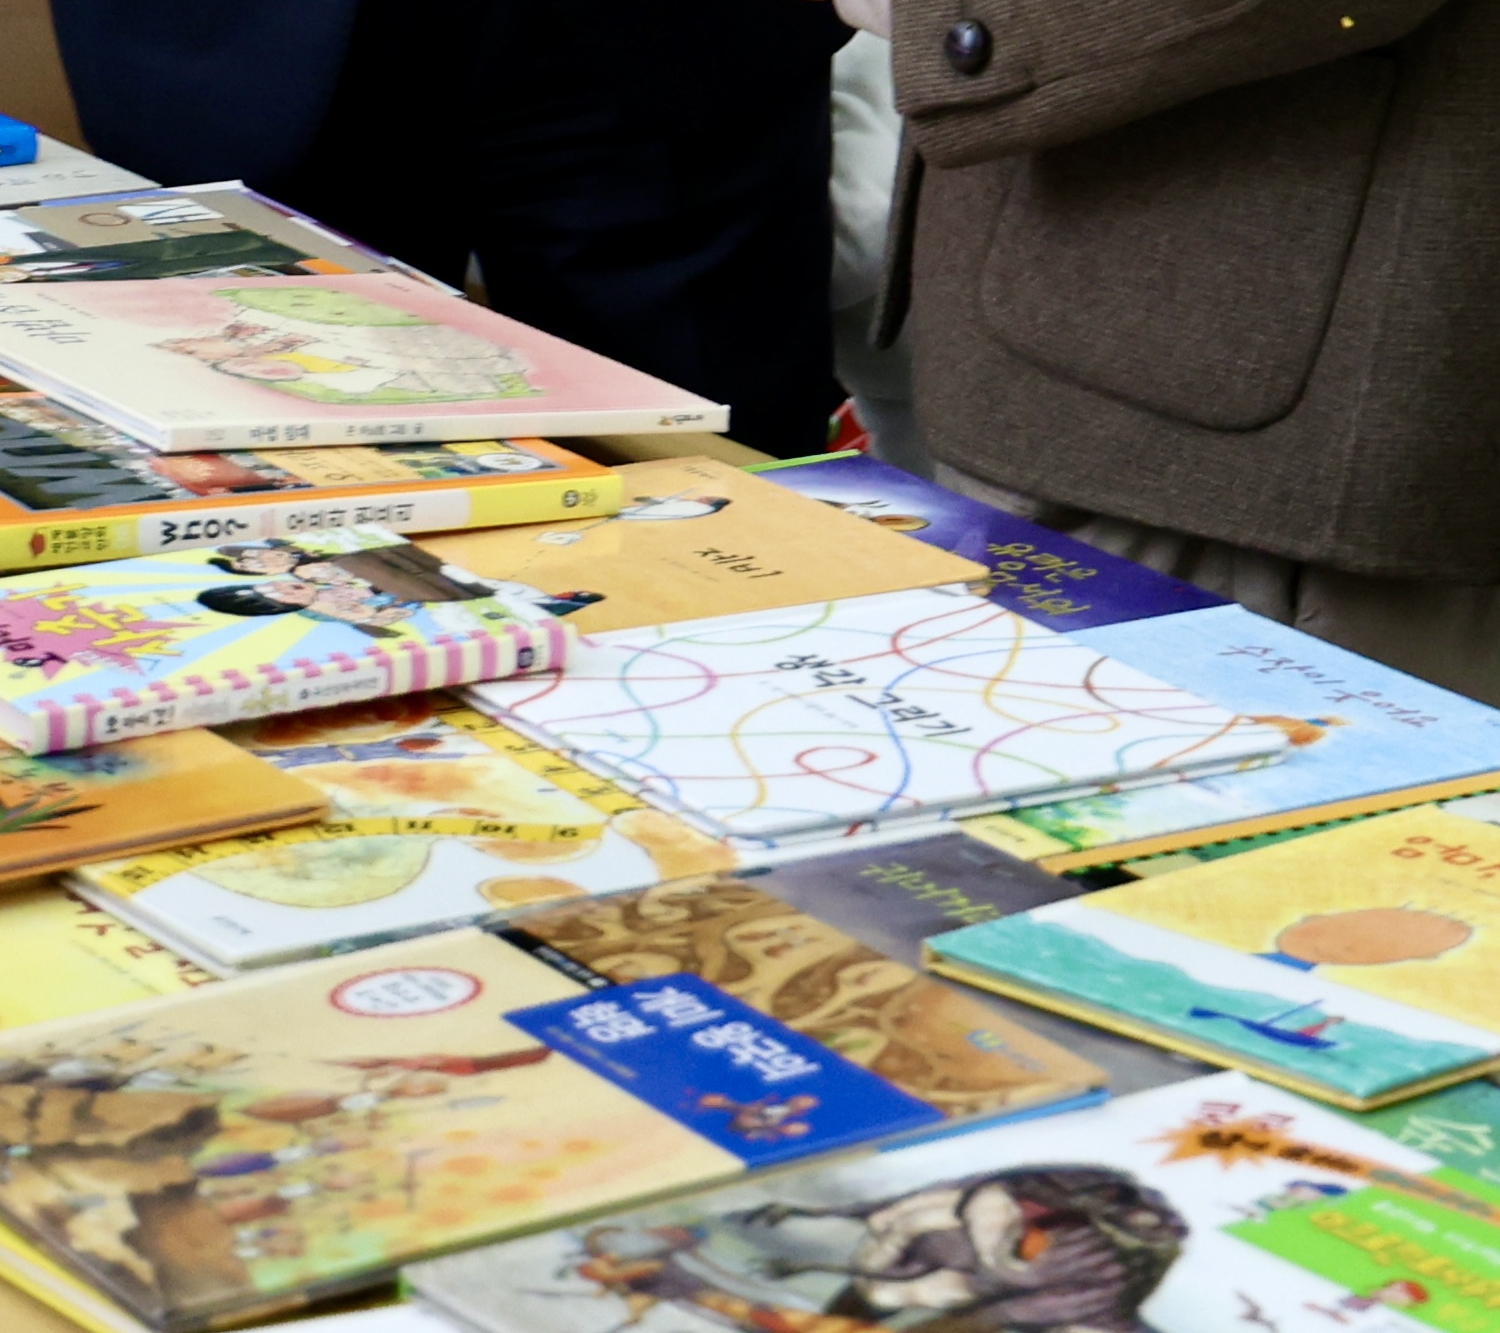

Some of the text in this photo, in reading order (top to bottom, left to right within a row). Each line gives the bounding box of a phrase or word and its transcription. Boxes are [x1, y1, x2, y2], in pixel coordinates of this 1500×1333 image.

[693, 545, 784, 580] 제비
[773, 650, 973, 741] 생각 그리기
